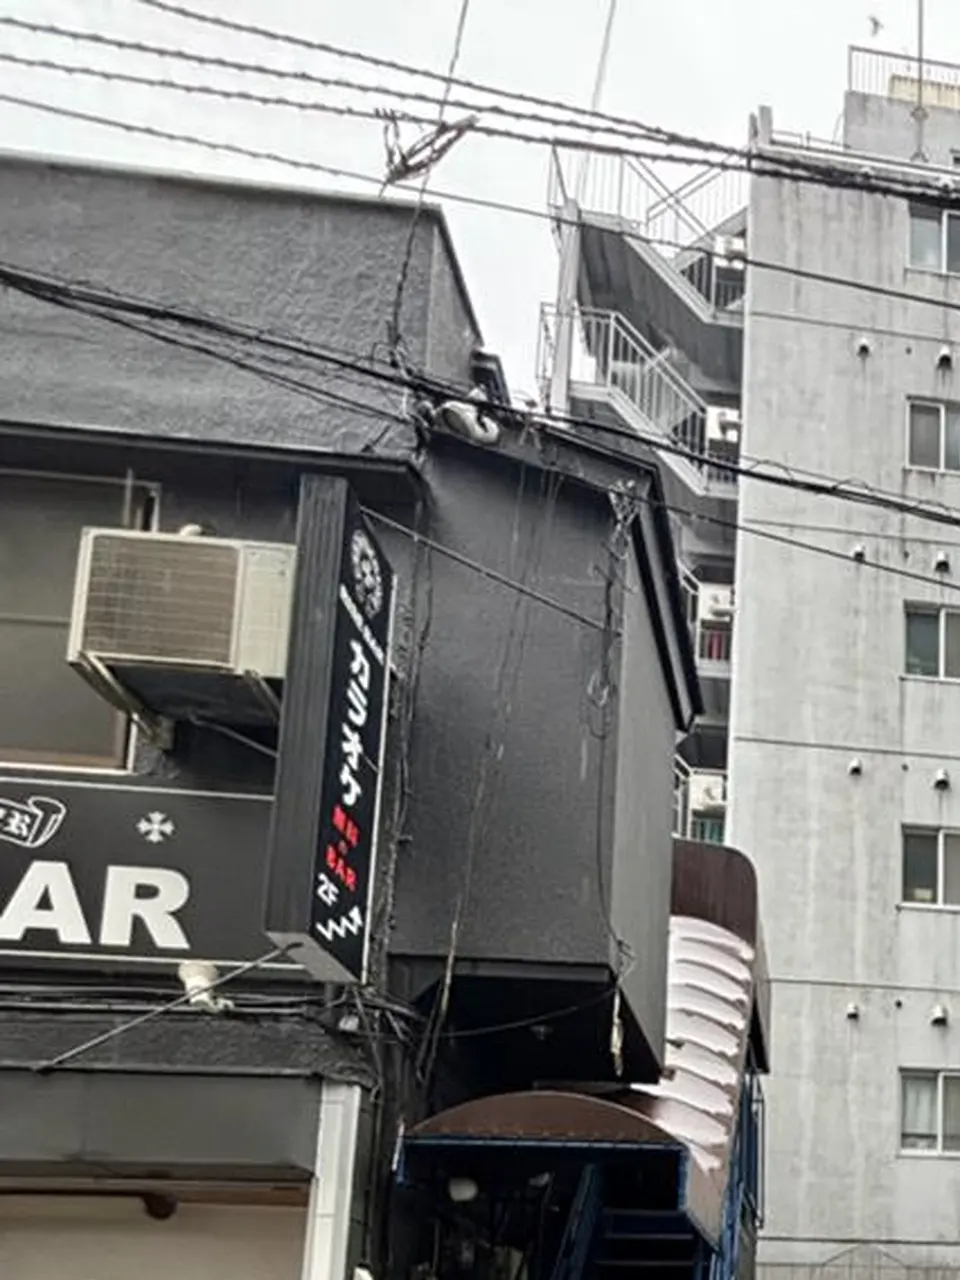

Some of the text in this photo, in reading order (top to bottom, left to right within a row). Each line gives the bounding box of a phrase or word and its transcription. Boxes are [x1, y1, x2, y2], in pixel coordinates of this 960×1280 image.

[339, 639, 371, 806] カラオケ
[317, 872, 339, 906] 2F
